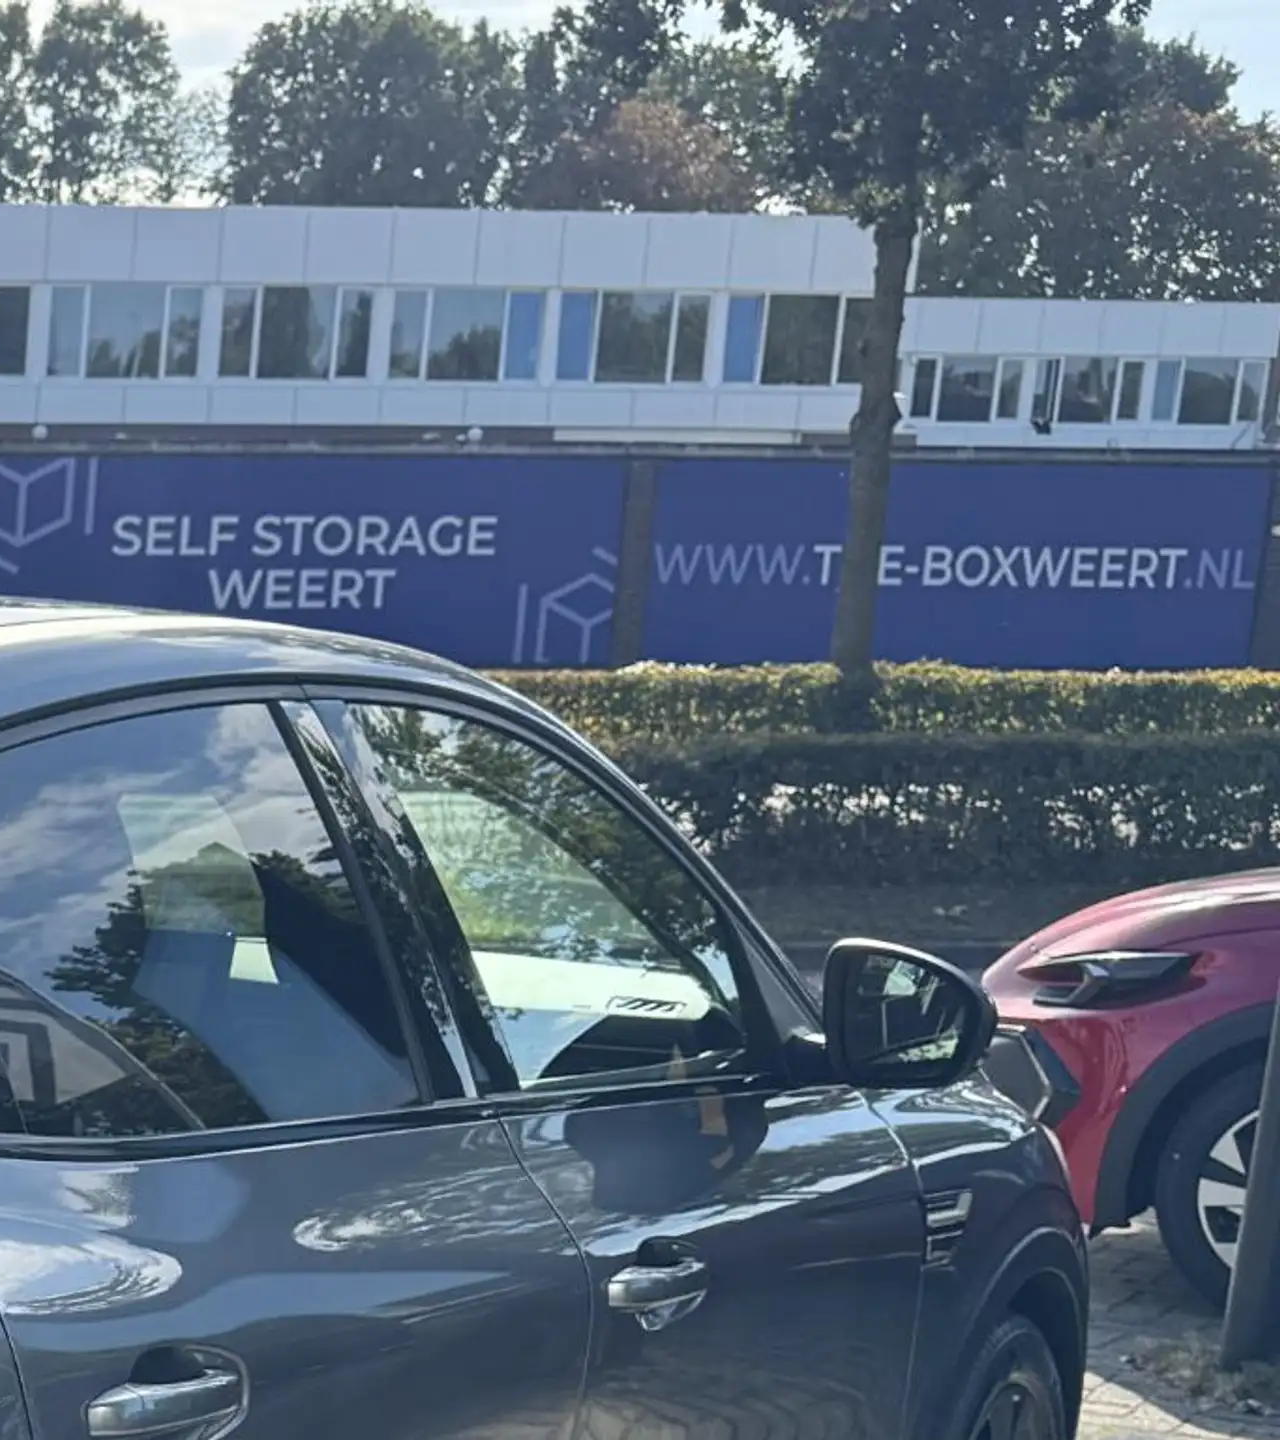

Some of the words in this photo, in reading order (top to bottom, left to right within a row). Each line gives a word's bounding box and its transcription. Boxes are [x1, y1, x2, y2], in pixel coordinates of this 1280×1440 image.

[111, 515, 241, 556] SELF
[250, 515, 498, 557] STORAGE
[653, 543, 1255, 590] WWW.TE-BOXWEERT.NL
[208, 568, 396, 610] WEERT
